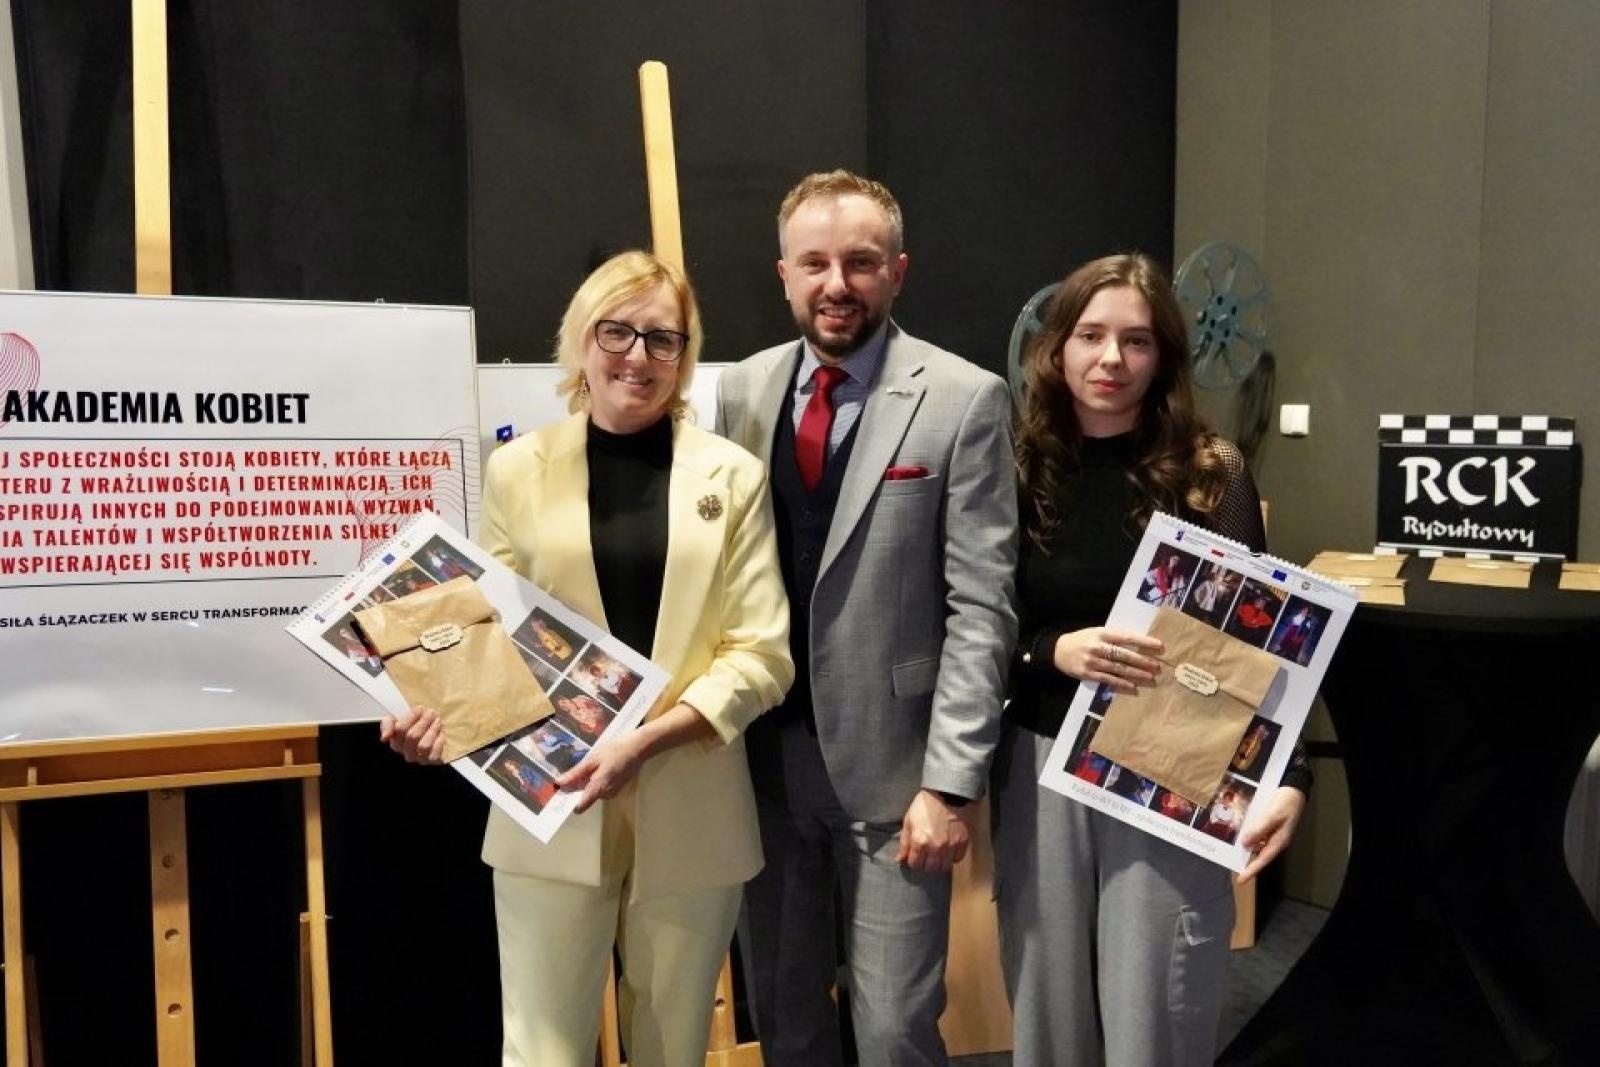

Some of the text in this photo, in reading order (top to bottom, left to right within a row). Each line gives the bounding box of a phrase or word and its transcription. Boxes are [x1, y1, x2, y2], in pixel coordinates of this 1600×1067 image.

[2, 390, 310, 424] AKADEMIA KOBIET
[20, 447, 169, 468] SPOŁECZNOŚCI
[180, 451, 236, 470] STOJĄ
[245, 451, 328, 468] KOBIETY,
[335, 446, 391, 467] KTÓRE
[399, 451, 451, 470] ŁĄCZĄ
[61, 478, 71, 493] Z
[81, 472, 231, 496] WRAŻLIWOŚCIĄ
[239, 477, 245, 491] I
[254, 475, 395, 495] DETERMINACJĄ.
[402, 475, 433, 491] ICH
[1398, 457, 1541, 507] RCK
[93, 502, 166, 518] INNYCH
[175, 502, 201, 517] DO
[210, 500, 356, 517] PODEJMOWANIA
[34, 524, 137, 545] TALENTÓW
[147, 529, 152, 544] I
[162, 522, 333, 543] WSPÓŁTWORZENIA
[1402, 515, 1535, 548] Rydułtowy
[0, 547, 318, 576] WSPIERAJĄCEJ SIĘ WSPÓLNOTY.
[40, 612, 128, 628] ŚLĄZACZEK
[132, 612, 147, 623] W
[151, 609, 199, 621] SERCU
